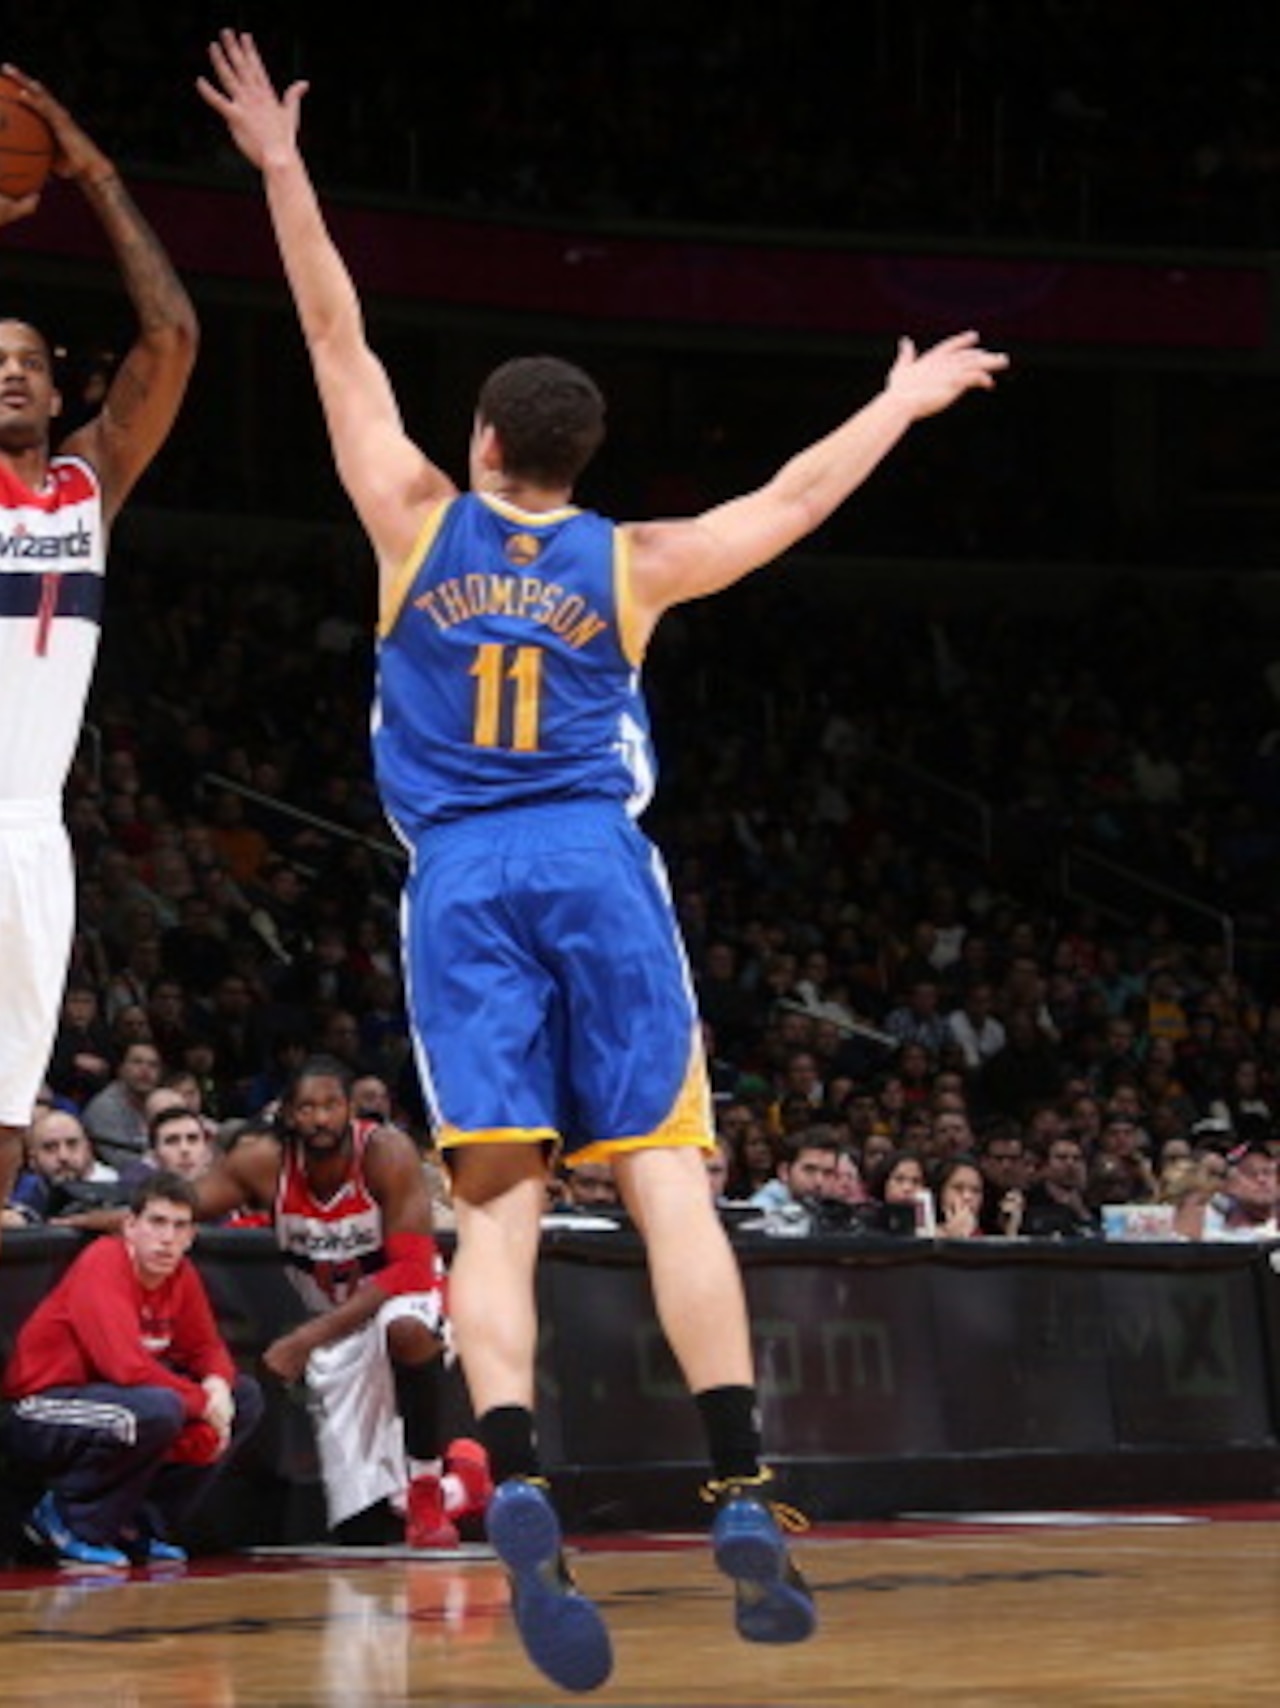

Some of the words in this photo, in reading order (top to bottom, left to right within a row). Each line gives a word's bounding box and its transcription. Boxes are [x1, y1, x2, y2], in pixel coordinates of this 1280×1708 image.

[34, 572, 62, 656] 1
[413, 573, 608, 649] THOMPSON
[469, 643, 546, 753] 11
